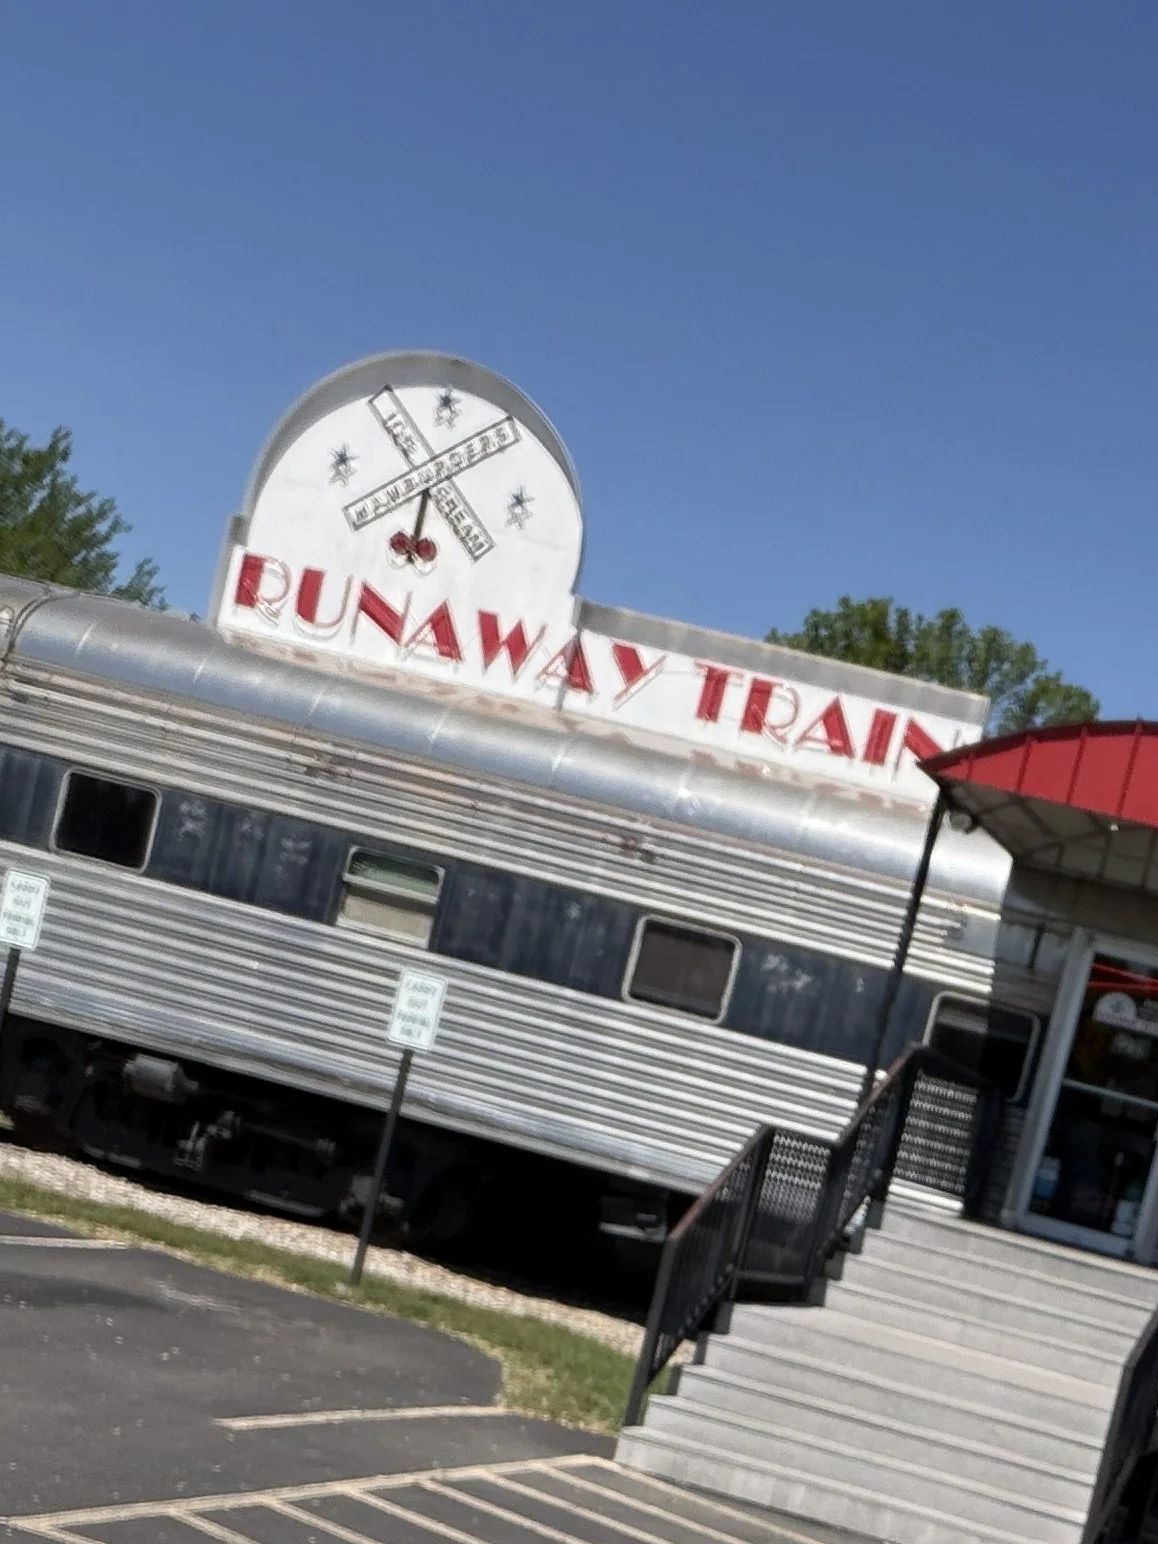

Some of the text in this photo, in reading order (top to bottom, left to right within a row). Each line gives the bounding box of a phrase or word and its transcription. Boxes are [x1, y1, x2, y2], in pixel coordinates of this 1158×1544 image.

[354, 426, 510, 522] HAMBURGERS
[234, 552, 962, 784] RUNAWAY TRAIN
